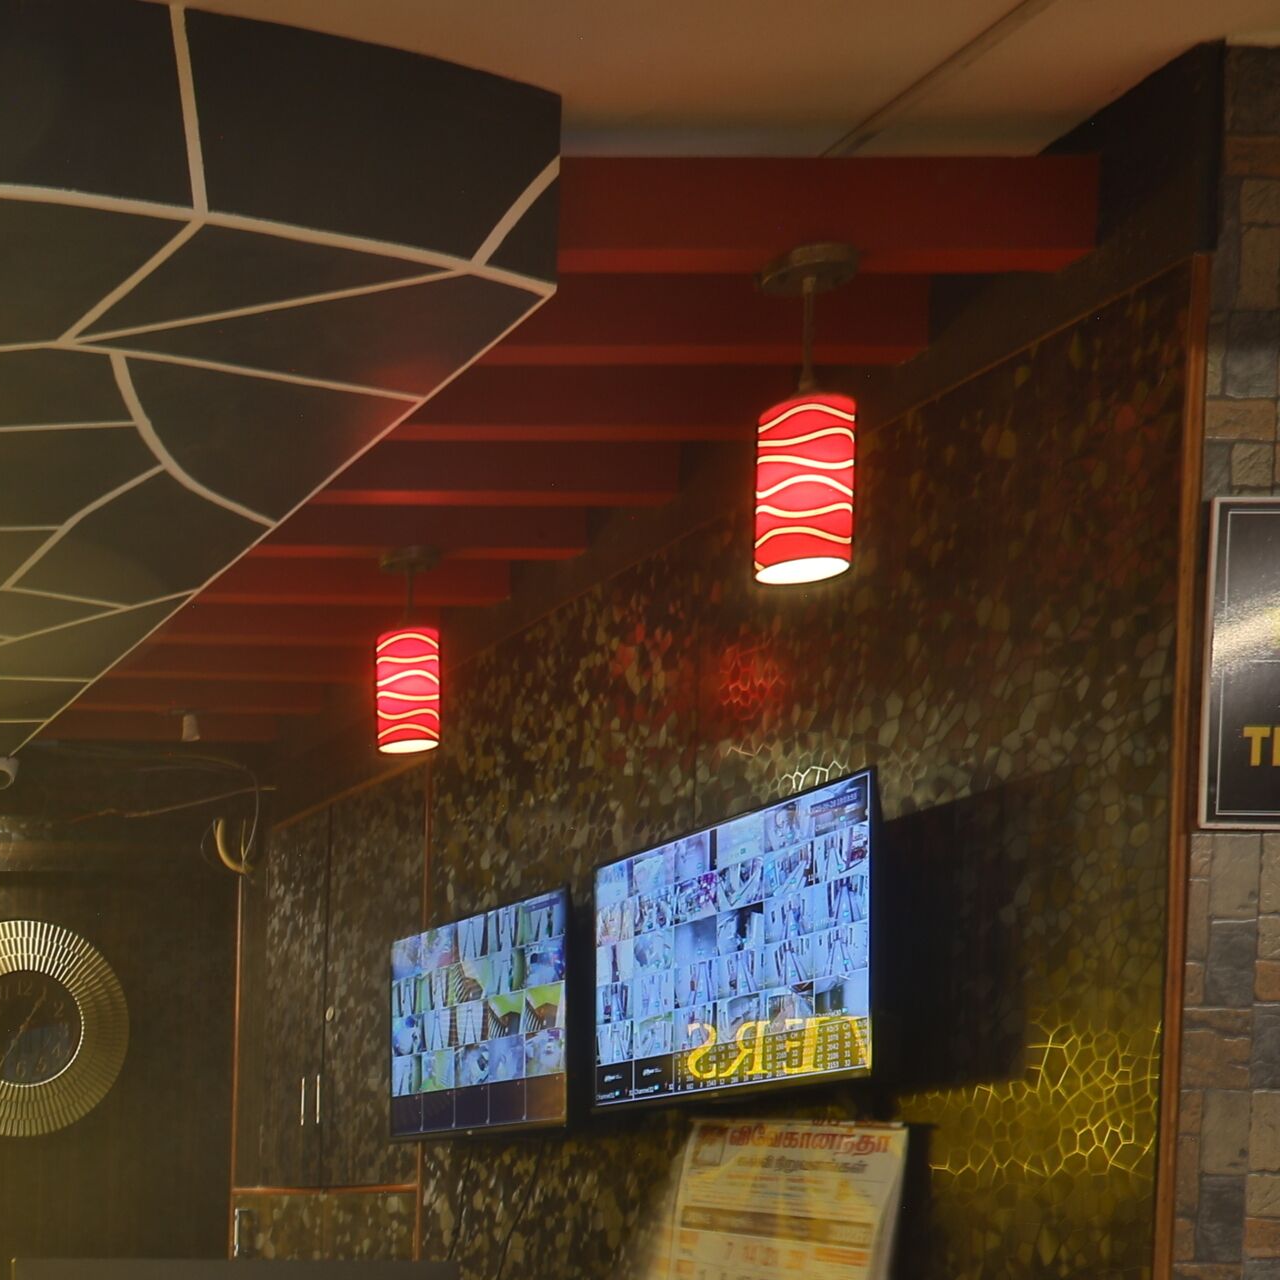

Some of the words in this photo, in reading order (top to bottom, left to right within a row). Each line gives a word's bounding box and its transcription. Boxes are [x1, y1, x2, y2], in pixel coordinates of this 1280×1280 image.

[1243, 727, 1280, 767] T
[17, 980, 32, 995] 12
[54, 1001, 64, 1017] 2
